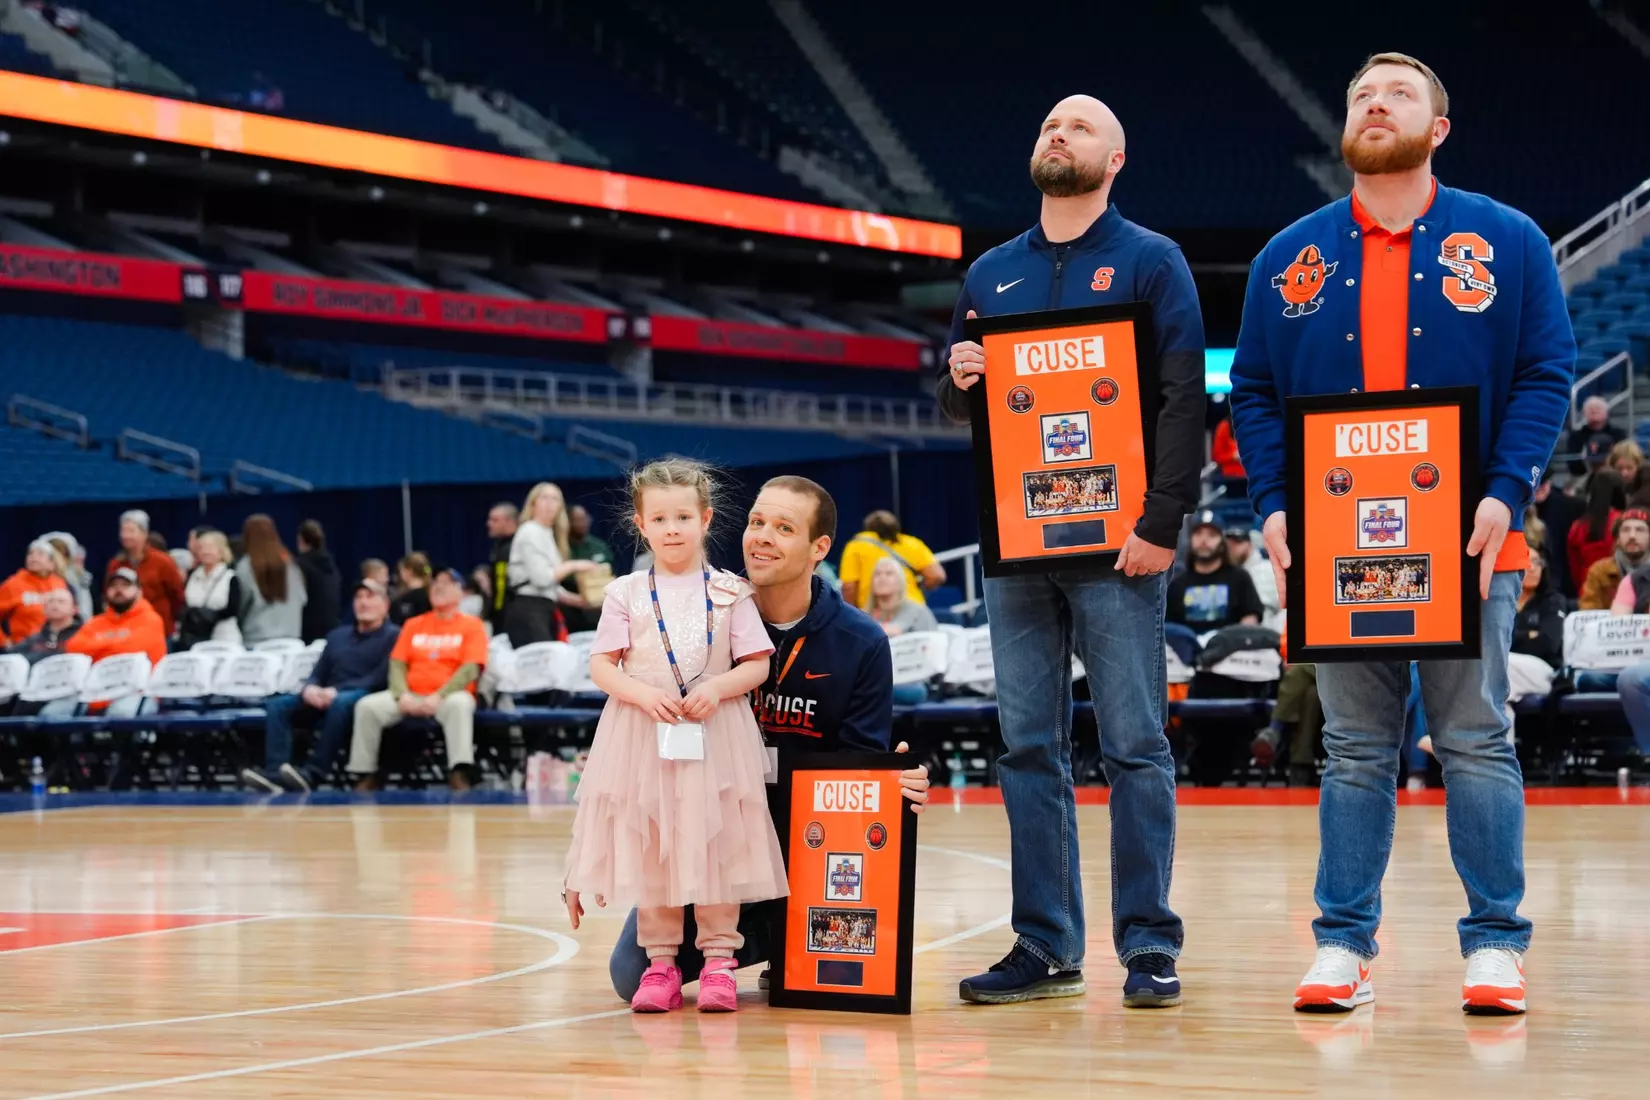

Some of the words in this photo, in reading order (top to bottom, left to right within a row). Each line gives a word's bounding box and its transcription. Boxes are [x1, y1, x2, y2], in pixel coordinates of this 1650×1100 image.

[1091, 267, 1115, 291] S
[1018, 338, 1097, 373] 'CUSE
[1340, 421, 1419, 454] 'CUSE
[817, 782, 873, 811] 'CUSE
